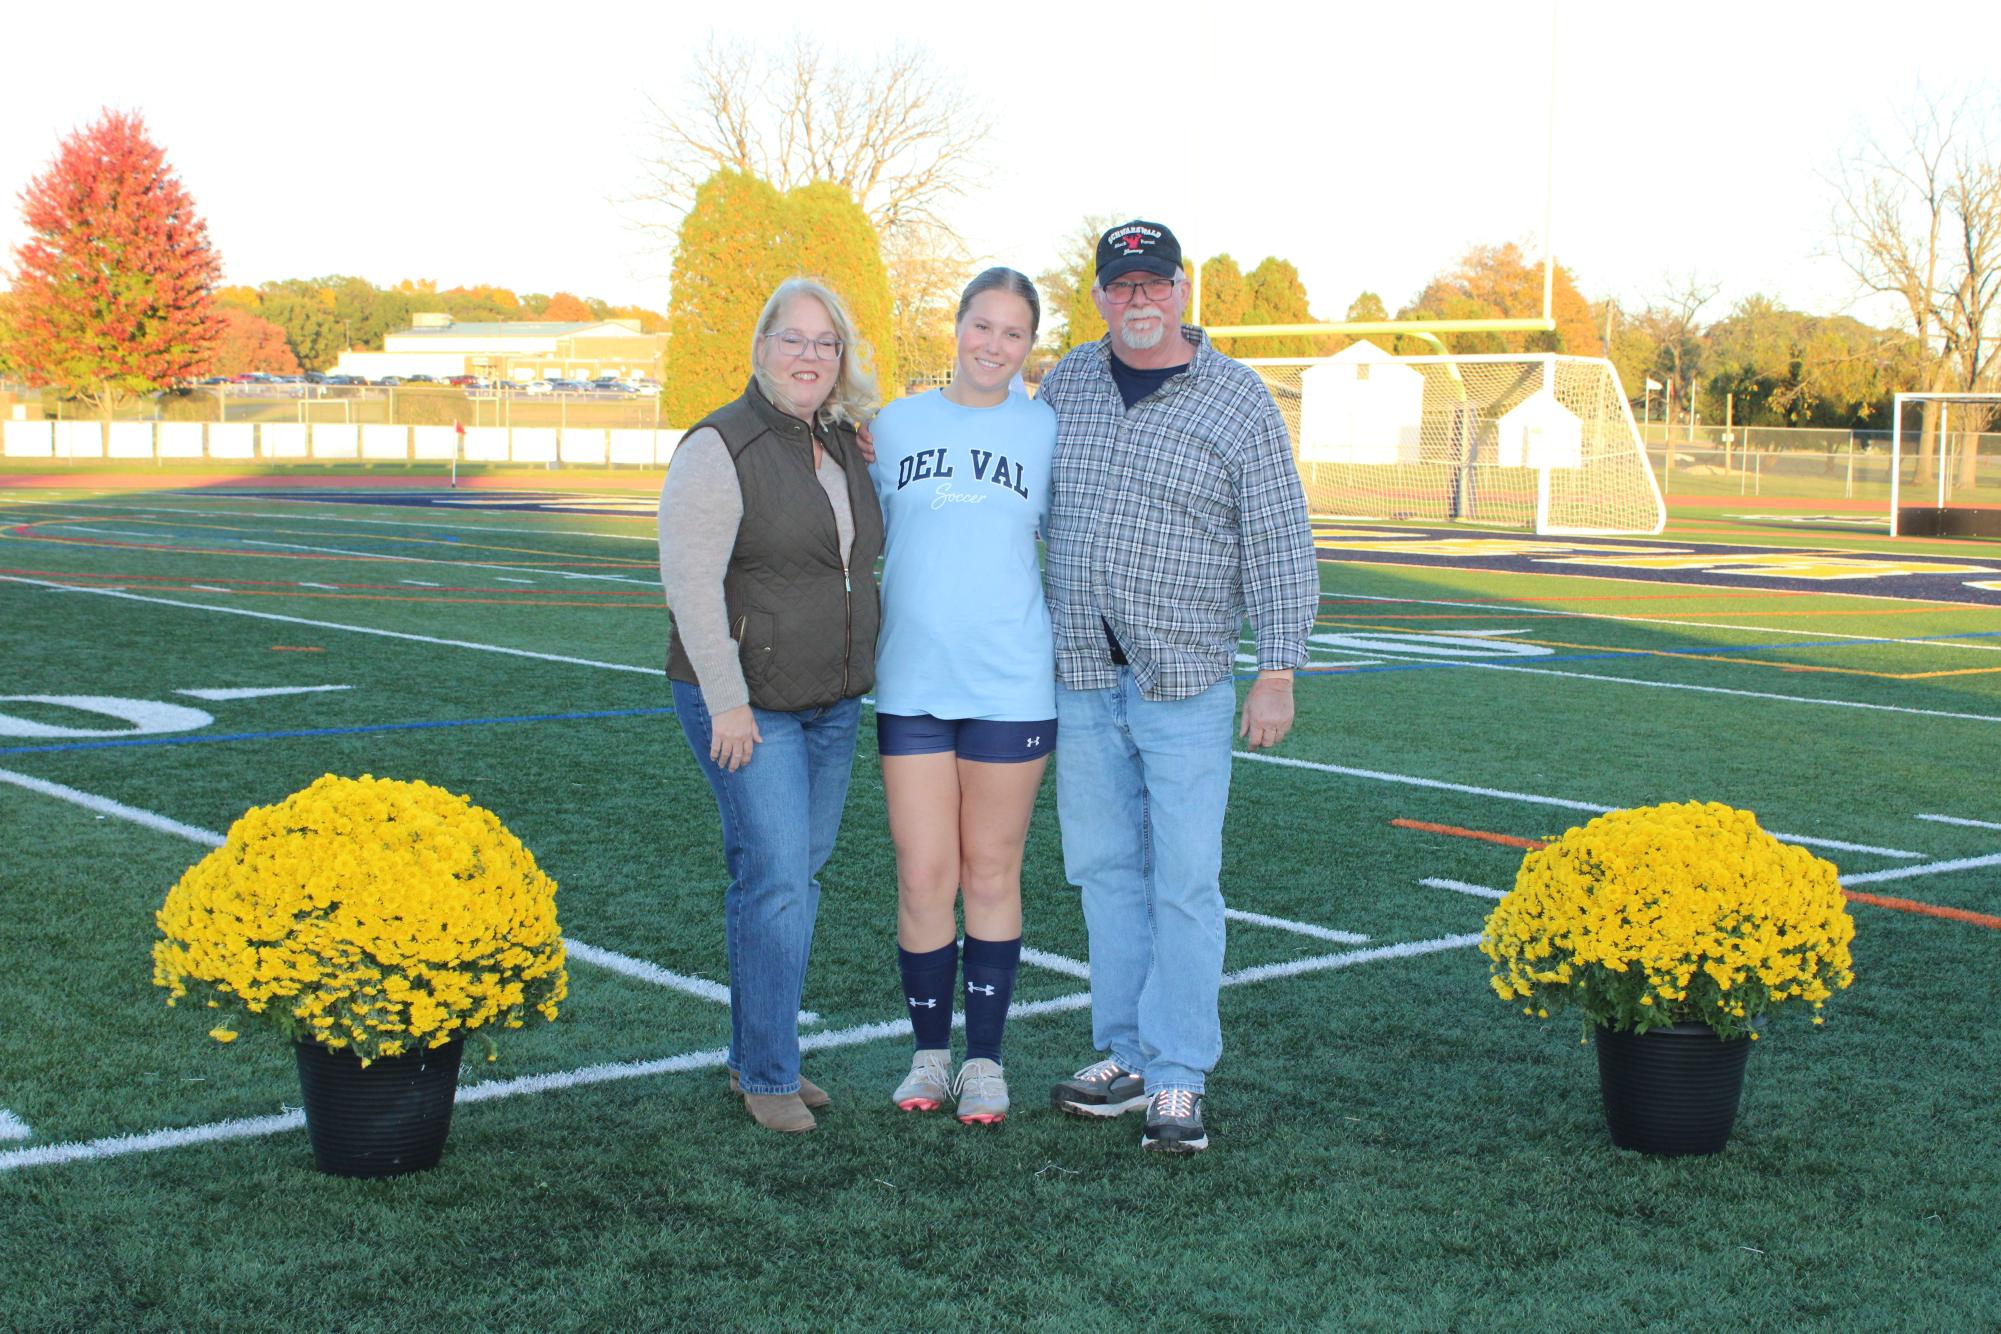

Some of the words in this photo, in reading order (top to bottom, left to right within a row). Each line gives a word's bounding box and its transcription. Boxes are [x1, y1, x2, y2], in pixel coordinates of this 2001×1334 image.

[897, 447, 953, 491] DEL
[970, 449, 1028, 500] VAL
[930, 482, 987, 511] Soccer
